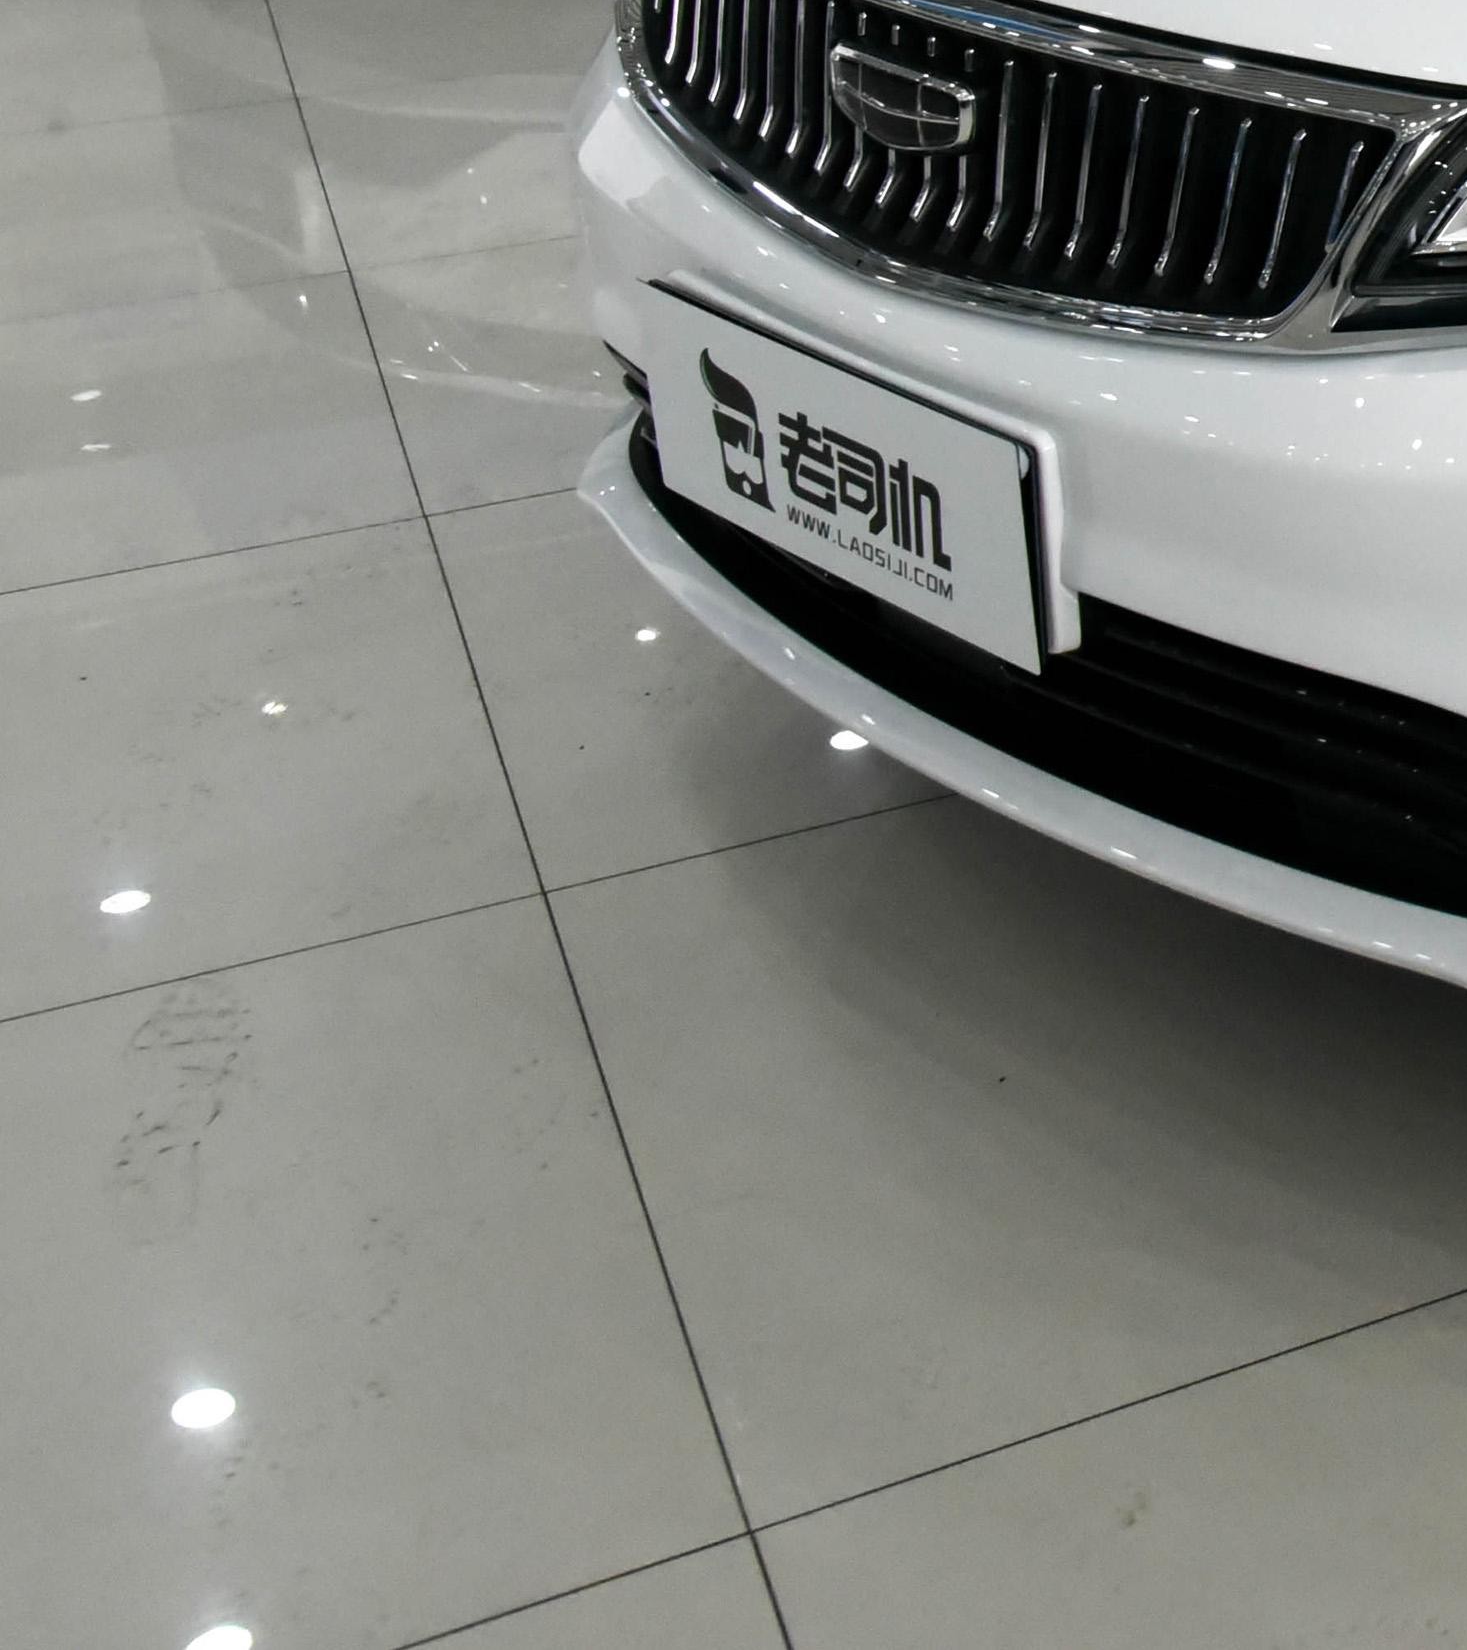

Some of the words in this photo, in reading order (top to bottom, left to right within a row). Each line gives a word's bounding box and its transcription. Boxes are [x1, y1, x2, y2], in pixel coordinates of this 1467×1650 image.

[778, 411, 953, 572] 老司机
[786, 503, 953, 601] WWW.LAOSIJI.COM
